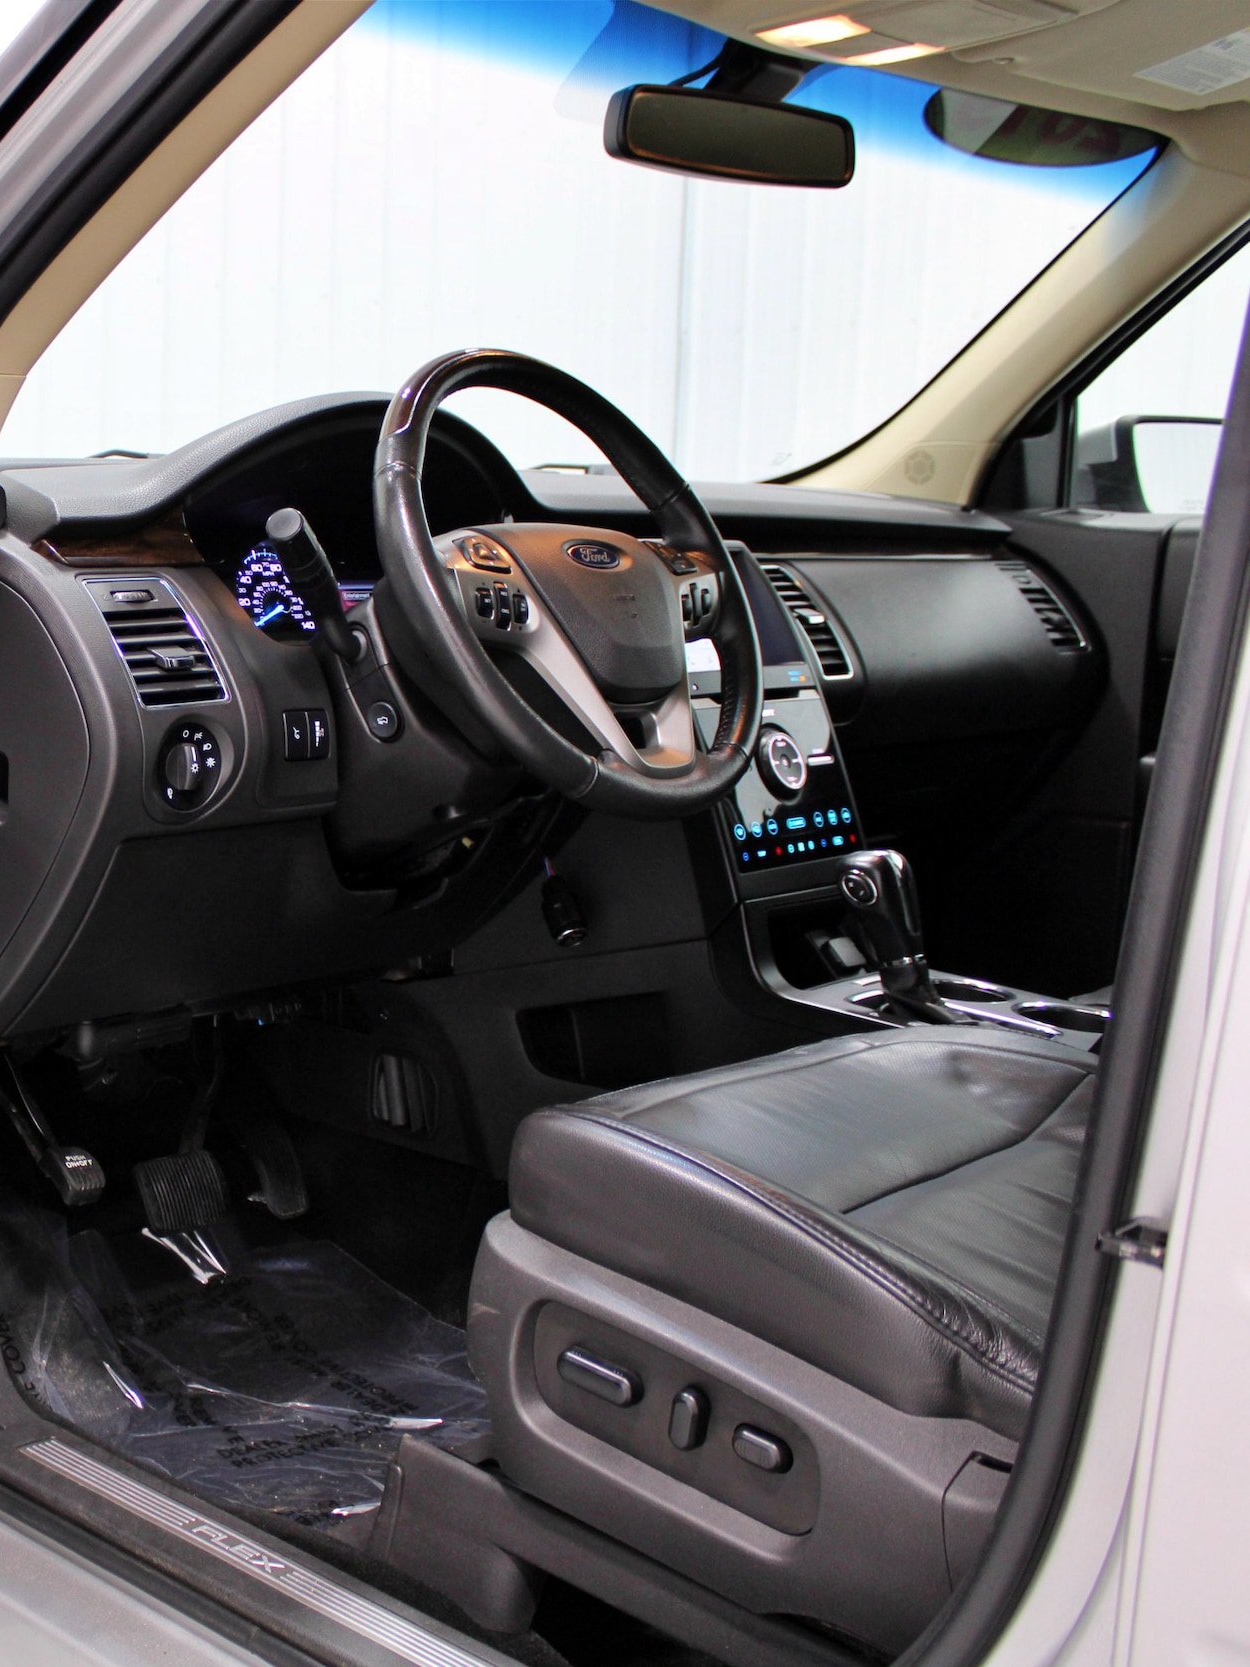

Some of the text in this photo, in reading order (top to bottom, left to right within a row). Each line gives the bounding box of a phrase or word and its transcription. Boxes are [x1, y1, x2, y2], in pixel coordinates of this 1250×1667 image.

[579, 546, 611, 564] Ford
[251, 564, 263, 572] 60
[240, 576, 252, 584] 40
[238, 598, 251, 606] 20
[301, 621, 316, 630] 140
[191, 1524, 285, 1574] FLEX
